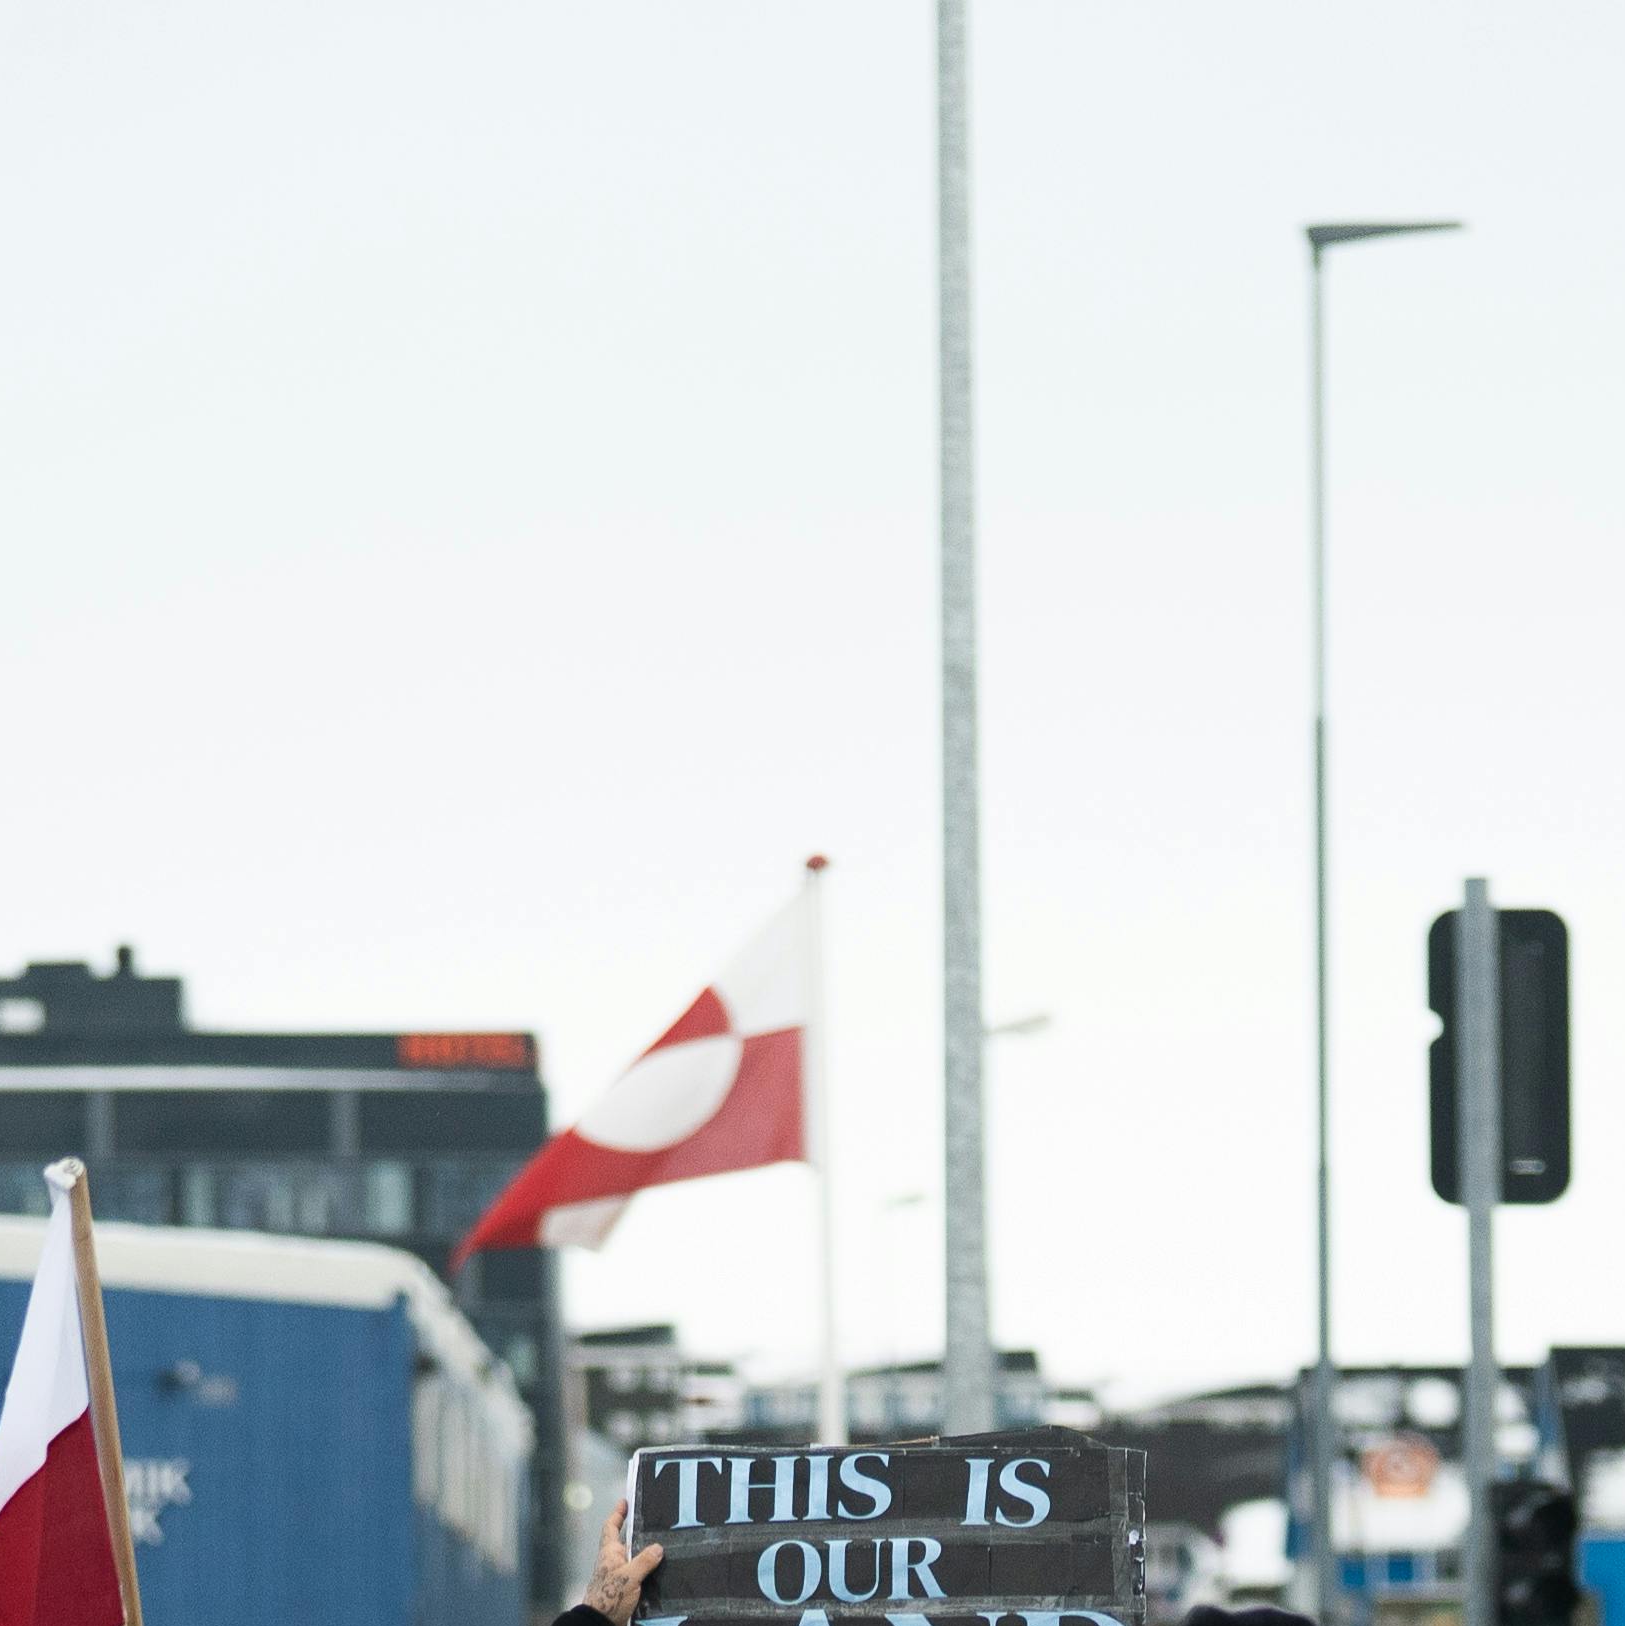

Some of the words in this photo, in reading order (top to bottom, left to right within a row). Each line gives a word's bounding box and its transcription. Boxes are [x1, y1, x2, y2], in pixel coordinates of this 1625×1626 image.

[655, 1452, 893, 1529] THIS
[960, 1457, 1052, 1529] IS
[757, 1536, 948, 1606] OUR
